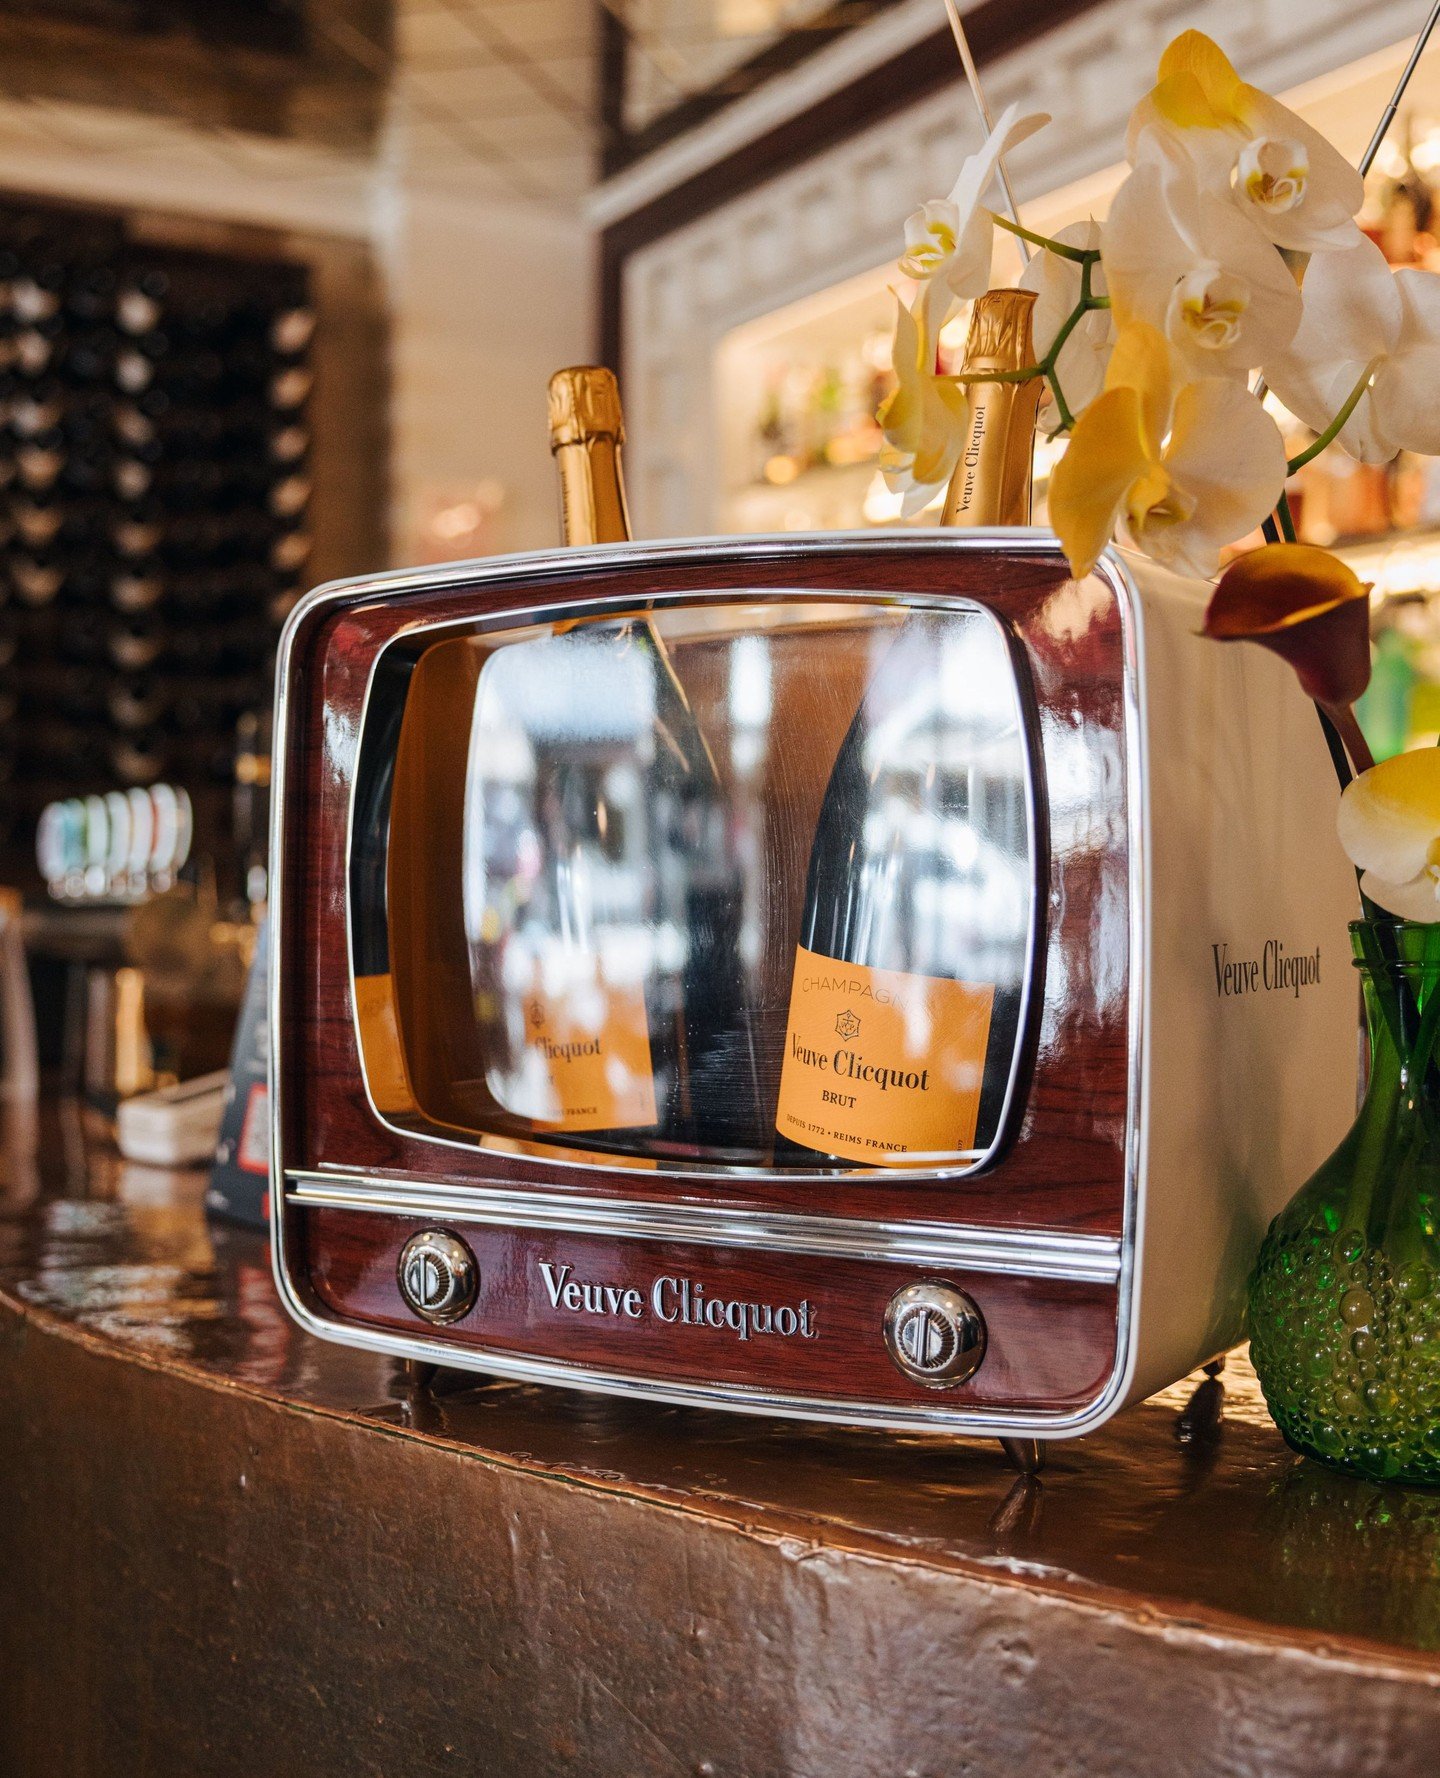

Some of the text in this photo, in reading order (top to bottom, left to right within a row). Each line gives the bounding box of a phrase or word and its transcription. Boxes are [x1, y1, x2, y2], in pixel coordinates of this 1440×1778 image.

[956, 406, 986, 514] Veuve Clicquot
[802, 976, 908, 1009] CHAMPAGN
[1211, 940, 1320, 998] Veuve Clicquot
[791, 1032, 930, 1091] Veuve Clicquot
[821, 1090, 857, 1108] BRUT
[786, 1113, 908, 1152] DEPUIS 1772 REIMS FRANCE
[538, 1260, 818, 1341] Veuve Clicquot
